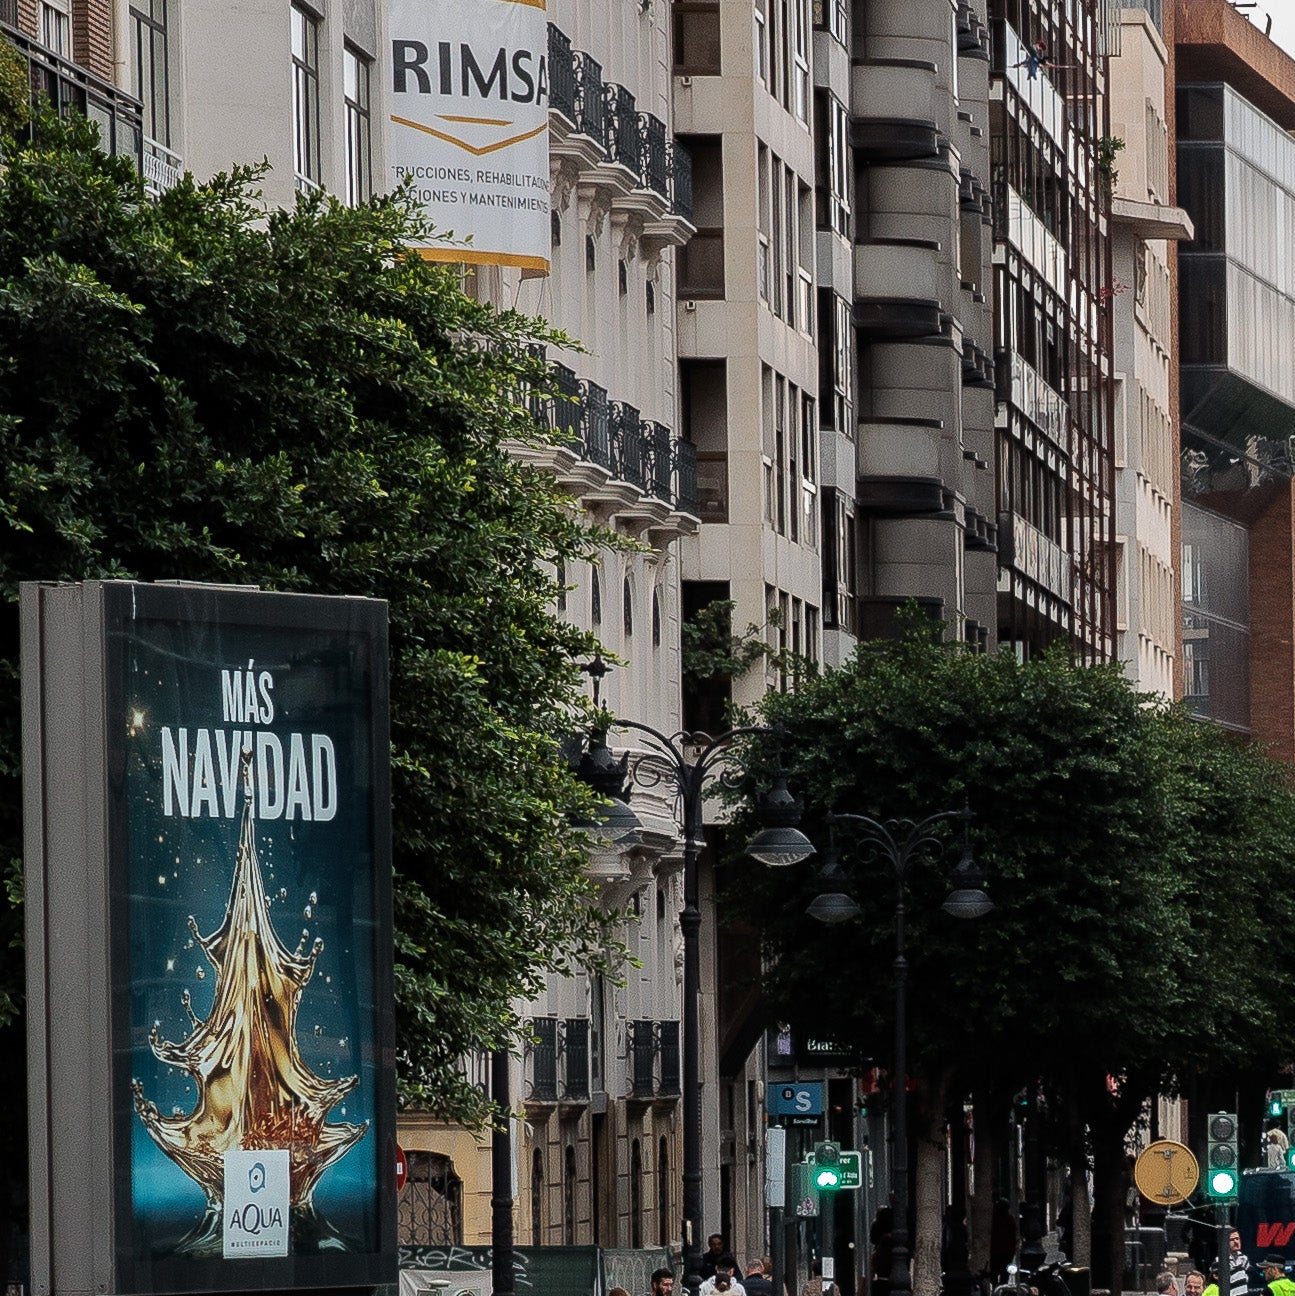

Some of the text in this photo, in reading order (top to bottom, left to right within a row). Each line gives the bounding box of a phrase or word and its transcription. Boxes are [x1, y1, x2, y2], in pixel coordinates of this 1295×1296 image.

[391, 166, 473, 183] RUCCIONES,
[408, 189, 458, 203] CIONES
[461, 191, 467, 200] Y
[221, 659, 274, 725] MÁS
[161, 727, 337, 822] NAVIDAD
[230, 1203, 283, 1235] AQUA
